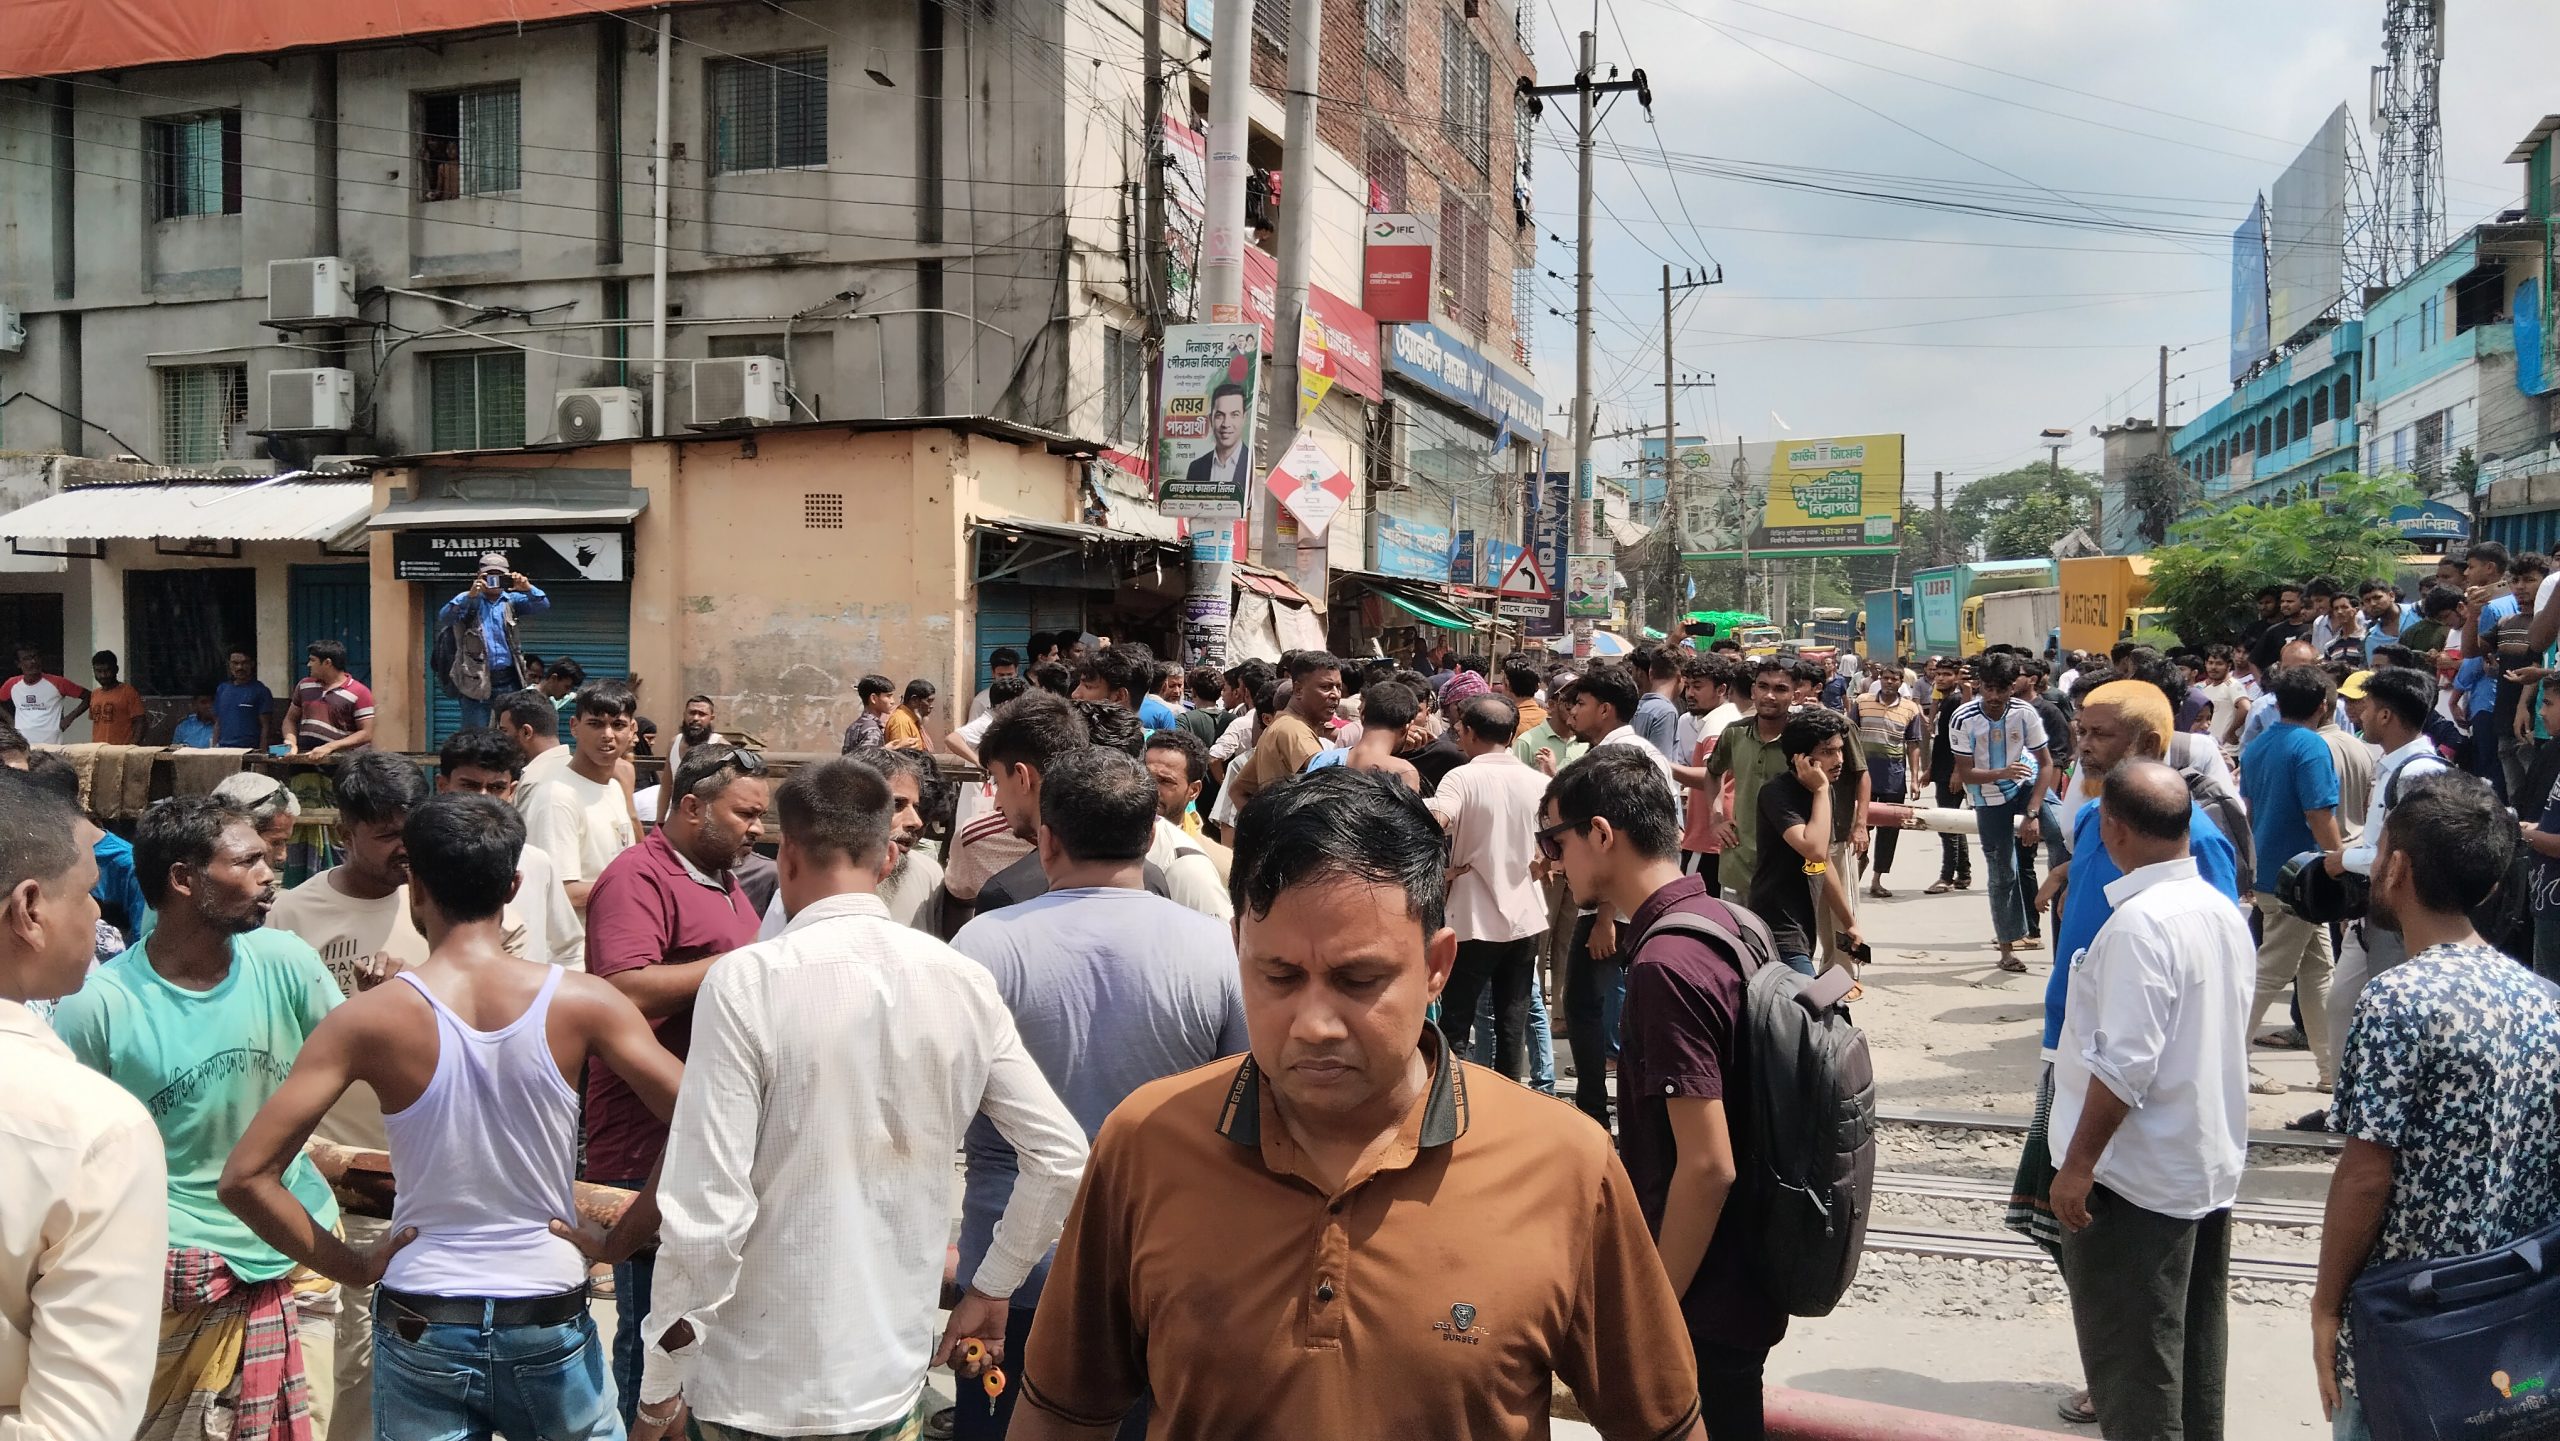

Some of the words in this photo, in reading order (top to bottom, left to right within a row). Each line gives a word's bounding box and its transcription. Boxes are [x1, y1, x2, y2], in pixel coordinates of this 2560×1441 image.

[1167, 354, 1200, 369] পৌরসভা
[1200, 354, 1231, 369] নির্বাচনে
[1396, 324, 1442, 377] ওয়ালটন
[1443, 351, 1467, 391] প্লাজা
[1170, 397, 1204, 414] মেয়র
[1519, 399, 1542, 434] PLAZA
[1166, 416, 1207, 435] পদপ্রার্থী
[1790, 449, 1816, 461] ক্রাউন
[1831, 446, 1863, 460] সিমেন্ট
[1169, 483, 1194, 493] মোস্তফা
[1195, 484, 1217, 493] কামাল
[1217, 482, 1235, 493] মিলন
[1808, 501, 1858, 518] নিরাপত্তা
[431, 538, 521, 549] BARBER
[1499, 605, 1520, 613] বামে
[1523, 606, 1546, 616] মোড়
